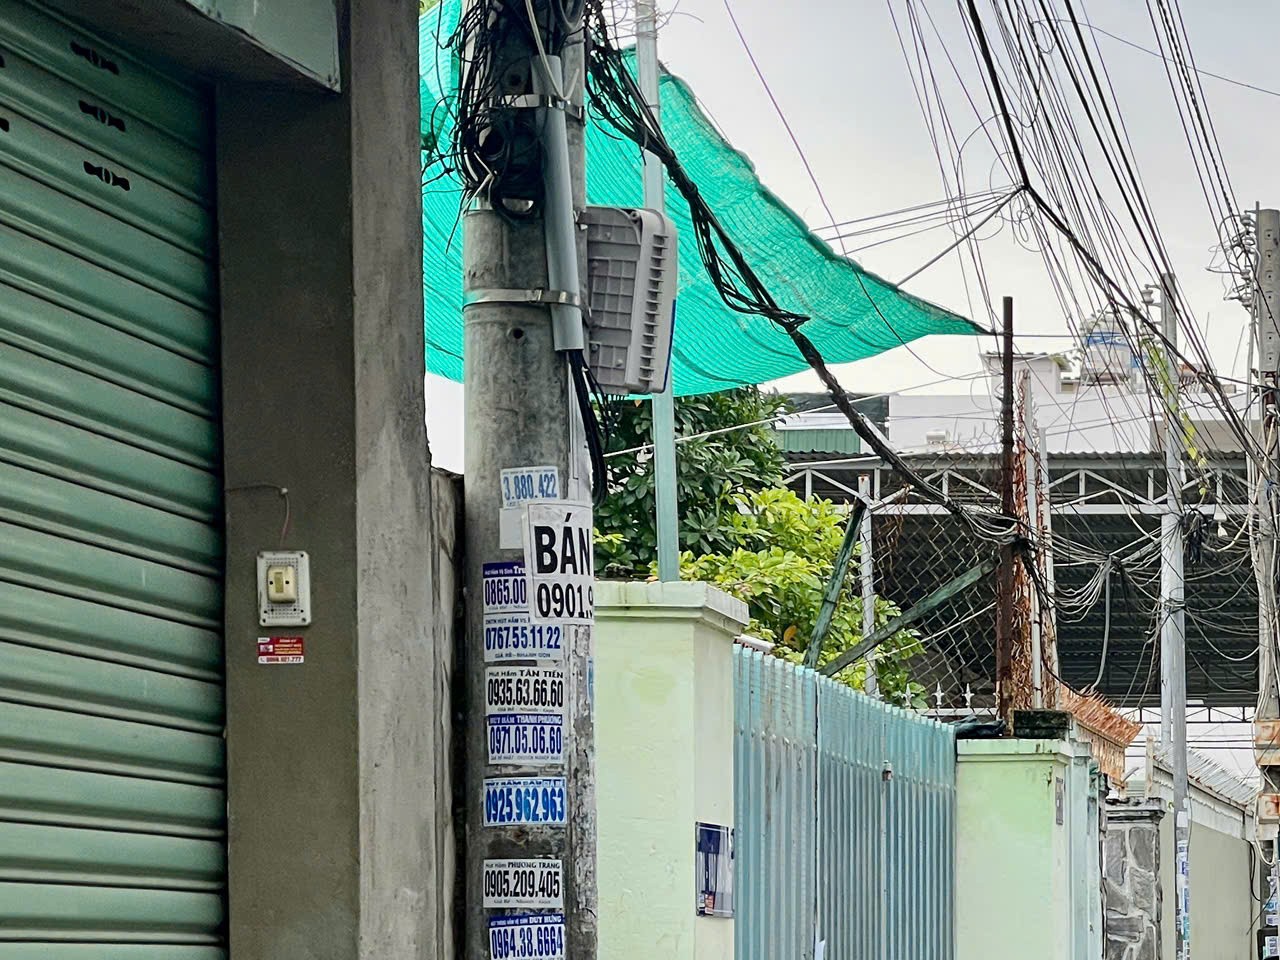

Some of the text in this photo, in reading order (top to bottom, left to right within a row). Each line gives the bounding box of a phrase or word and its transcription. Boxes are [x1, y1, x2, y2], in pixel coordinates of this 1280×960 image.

[503, 473, 557, 500] 3.880.422
[534, 512, 591, 576] BÁN
[485, 578, 526, 606] 0865.00
[486, 626, 560, 650] 0767.55.11.22
[488, 679, 563, 707] 0935.63.66.60
[490, 726, 561, 754] 0971.05.06.60
[486, 788, 564, 822] 0925.962.963
[485, 870, 560, 898] 0905.209.405
[492, 926, 563, 960] 0964.38.6664
